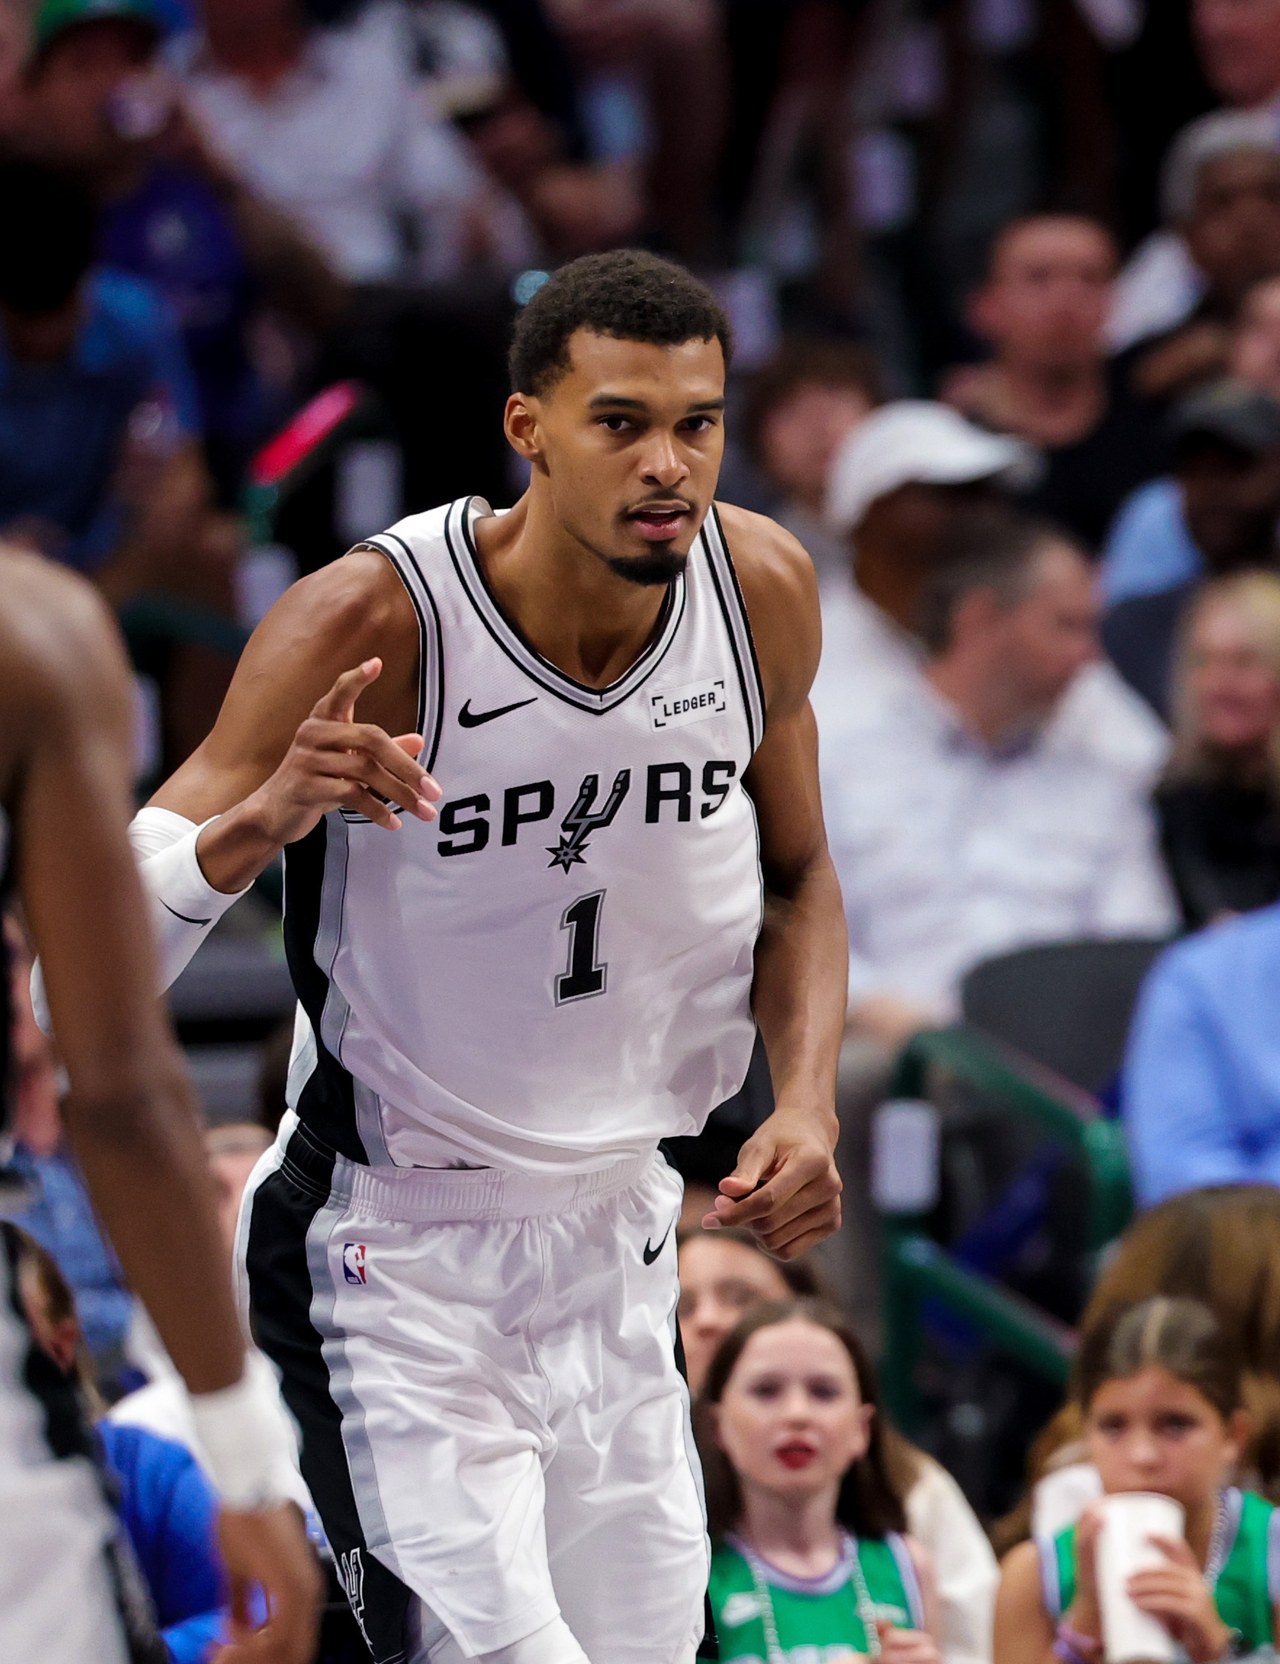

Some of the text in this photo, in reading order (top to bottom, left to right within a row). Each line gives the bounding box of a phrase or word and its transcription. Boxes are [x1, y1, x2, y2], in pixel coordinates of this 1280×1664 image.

[663, 692, 716, 717] LEDGER
[437, 760, 737, 875] SPURS
[554, 888, 608, 1008] 1
